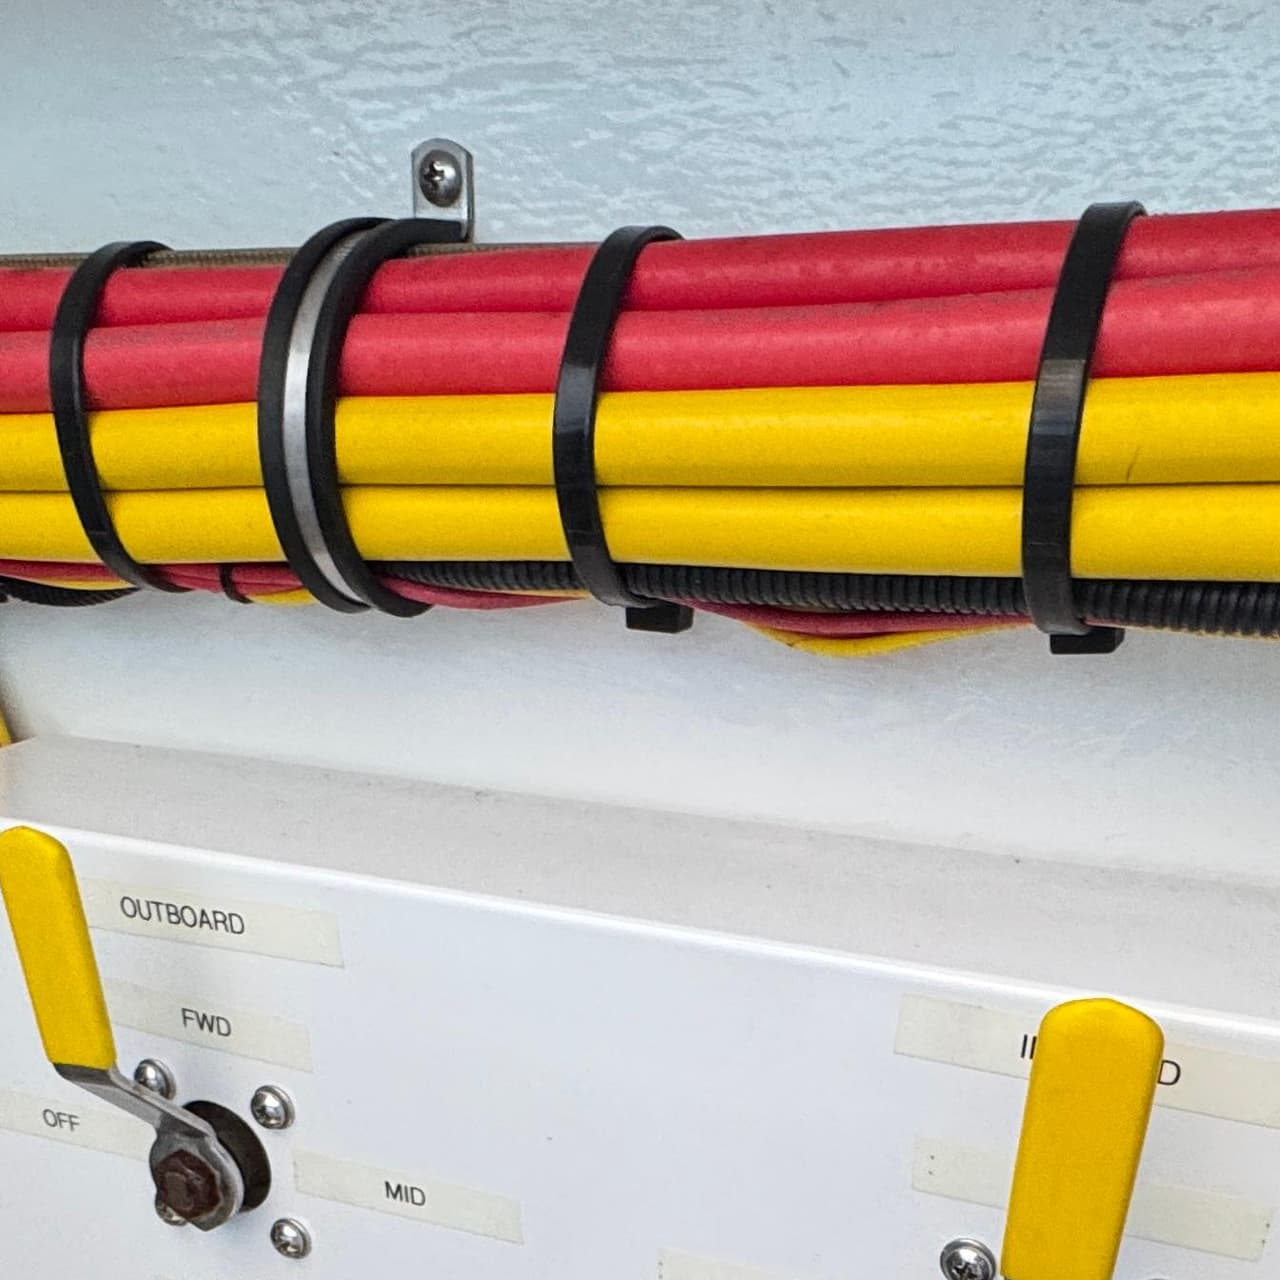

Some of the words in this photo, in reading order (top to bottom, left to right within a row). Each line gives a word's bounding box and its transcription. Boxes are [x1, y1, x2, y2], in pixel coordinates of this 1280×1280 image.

[119, 895, 245, 935] OUTBOARD
[180, 1007, 232, 1037] FWD
[42, 1108, 80, 1132] OFF
[384, 1180, 426, 1207] MID
